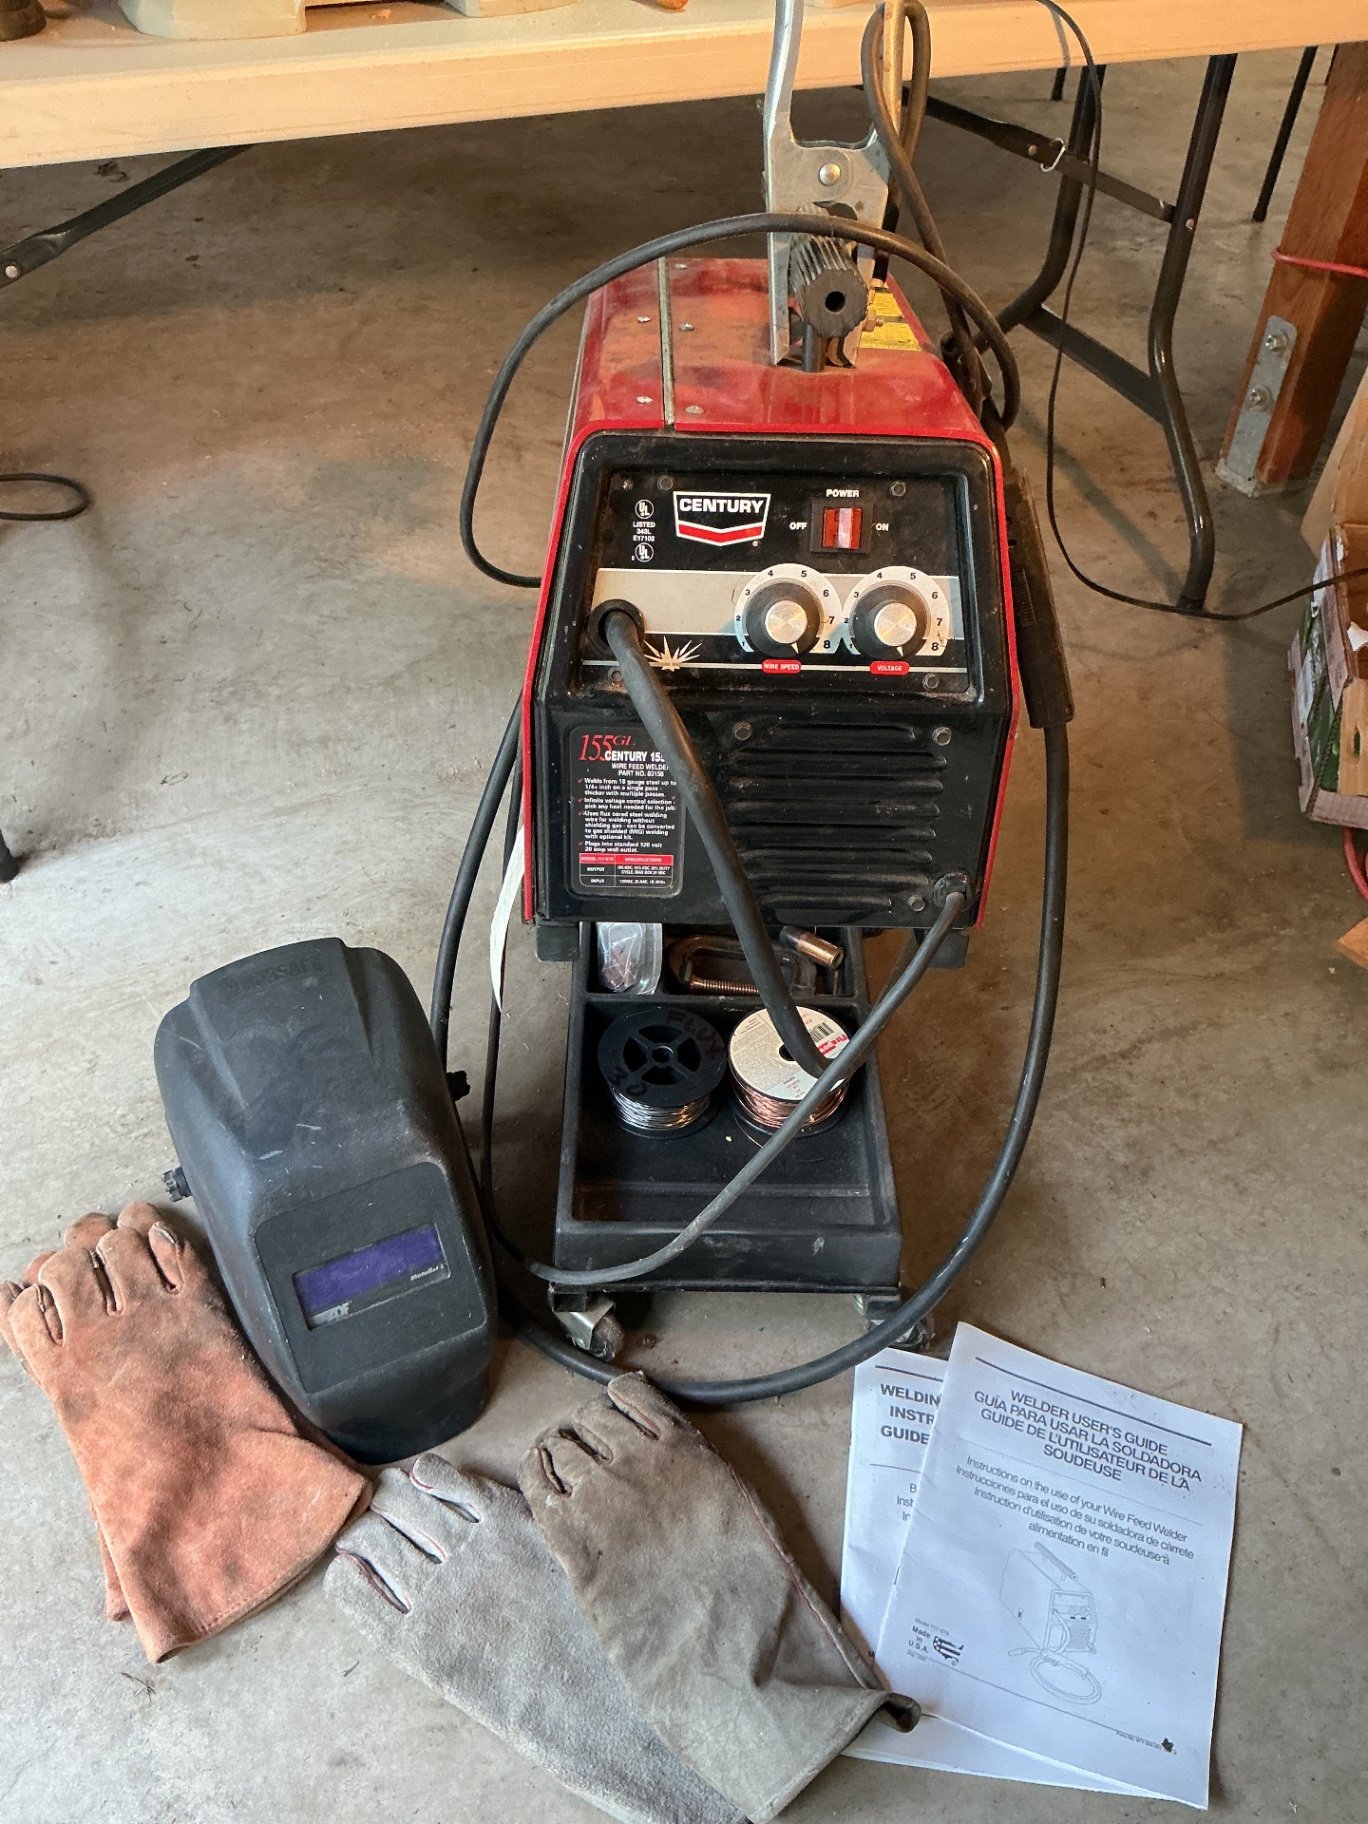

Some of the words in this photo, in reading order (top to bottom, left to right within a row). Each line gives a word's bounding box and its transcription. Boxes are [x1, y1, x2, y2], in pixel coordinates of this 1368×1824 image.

[826, 489, 860, 498] POWER
[679, 498, 764, 514] CENTURY
[789, 522, 807, 531] OFF
[875, 523, 889, 531] ON
[801, 570, 807, 578] 5
[910, 572, 917, 580] 5
[853, 591, 859, 599] 3
[828, 616, 835, 625] 7
[936, 618, 943, 627] 7
[823, 640, 831, 649] 8
[931, 642, 939, 651] 8
[604, 750, 648, 762] CENTURY
[890, 1405, 935, 1425] INSTR
[1010, 1390, 1069, 1420] WELDER
[1072, 1412, 1122, 1439] USER'S
[1124, 1432, 1168, 1456] GUIDE
[881, 1424, 930, 1445] GUIDE
[974, 1391, 1007, 1412] GUÍA
[1010, 1404, 1047, 1427] PARA
[1050, 1418, 1088, 1441] USAR
[1091, 1433, 1110, 1449] LA
[1112, 1442, 1202, 1482] SOLDADORA
[980, 1408, 1025, 1432] GUIDE
[1026, 1423, 1047, 1440] DE
[1048, 1432, 1146, 1476] L'UTILISATEUR
[1148, 1467, 1169, 1484] DE
[1043, 1444, 1122, 1482] SOUDEUSE
[966, 1456, 1019, 1483] Instructions
[1020, 1478, 1033, 1488] on
[1034, 1481, 1049, 1494] the
[1051, 1488, 1069, 1500] use
[1070, 1496, 1081, 1505] of
[1080, 1499, 1102, 1512] your
[1103, 1504, 1125, 1521] Wire
[1127, 1514, 1152, 1531] Feed
[1153, 1522, 1188, 1543] Welder
[956, 1465, 1016, 1496] Instrucciones
[1017, 1490, 1039, 1504] para
[1040, 1498, 1050, 1508] el
[1051, 1504, 1069, 1515] uso
[1070, 1508, 1083, 1520] de
[1083, 1514, 1096, 1525] su
[1097, 1519, 1145, 1543] soldadora
[1146, 1536, 1159, 1547] de
[974, 1486, 1021, 1512] Instruction
[1022, 1506, 1073, 1531] d'utilisation
[1074, 1524, 1087, 1535] de
[1088, 1529, 1113, 1545] votre
[1113, 1538, 1161, 1562] soudeuse
[1028, 1522, 1085, 1549] alimentation
[1086, 1544, 1100, 1554] en
[1101, 1546, 1109, 1558] fil
[912, 1626, 931, 1639] Made
[916, 1635, 923, 1644] in
